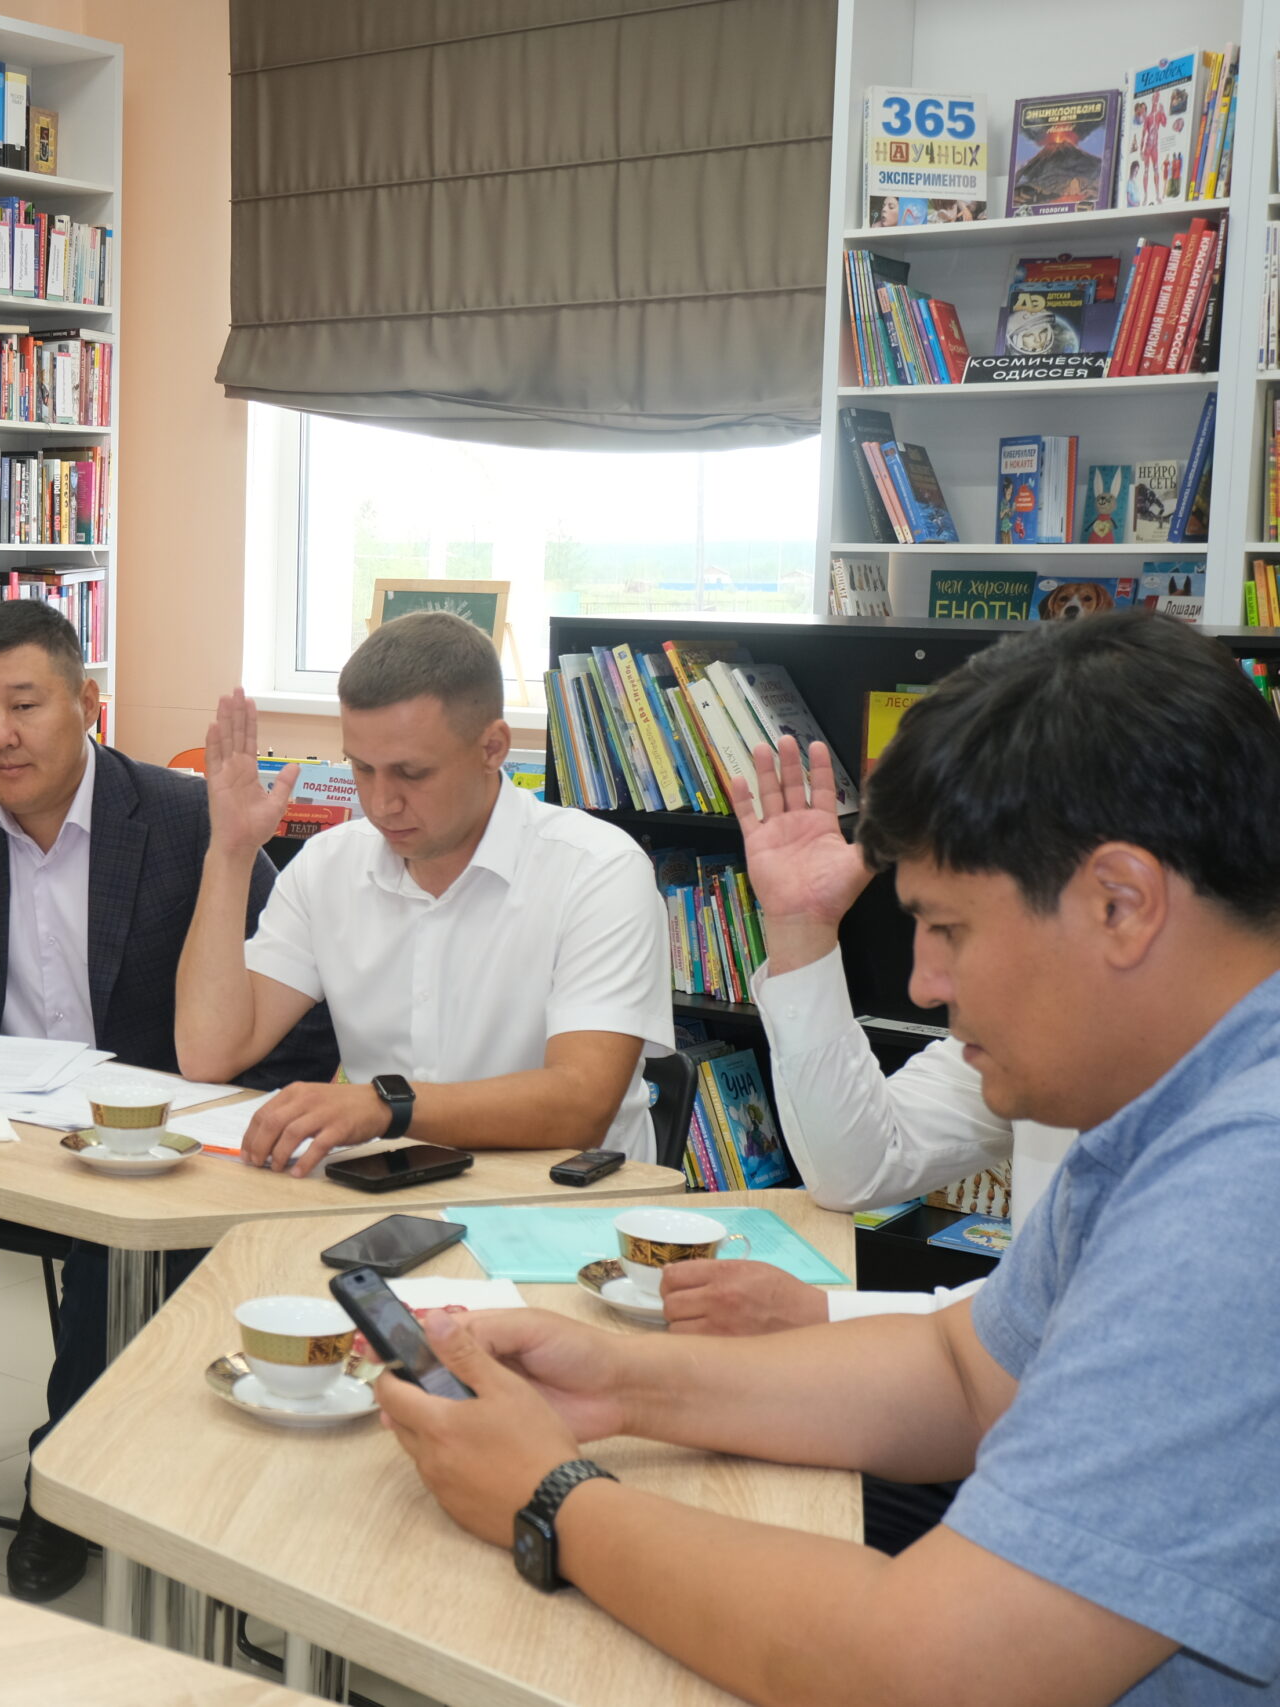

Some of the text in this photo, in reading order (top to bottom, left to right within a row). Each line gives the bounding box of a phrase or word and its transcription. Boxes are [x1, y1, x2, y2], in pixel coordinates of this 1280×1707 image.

[882, 97, 976, 140] 365
[1026, 103, 1101, 120] ЭНЦИКЛОПЕДИЯ
[875, 141, 980, 166] НАУЧНЫХ
[879, 171, 977, 188] ЭКСПЕРИМЕНТОВ
[1039, 206, 1069, 214] ГЕОЛОГИЯ
[1182, 233, 1198, 268] России
[1013, 293, 1046, 313] ДЭ
[1143, 248, 1183, 359] КРАСНАЯ КНИГА ЗЕМЛИ
[1167, 236, 1210, 370] КРАСНАЯ КНИГА РОССИИ
[970, 356, 1106, 368] КОСМИЧЕСКА
[993, 368, 1089, 380] ОДИССЕЯ
[1003, 448, 1037, 459] КИБЕРБУЛЛЕР
[1009, 459, 1033, 468] НОКАУТЕ
[1138, 463, 1176, 478] НЕЙРО
[1149, 477, 1177, 490] СЕТЬ
[968, 581, 1029, 599] хороши
[935, 600, 1027, 620] ЕНОТЫ
[1164, 601, 1202, 617] Лошади
[303, 782, 358, 794] ПОДЗЕМНОГ
[291, 824, 317, 833] ТЕАТР
[721, 1071, 757, 1100] УНА
